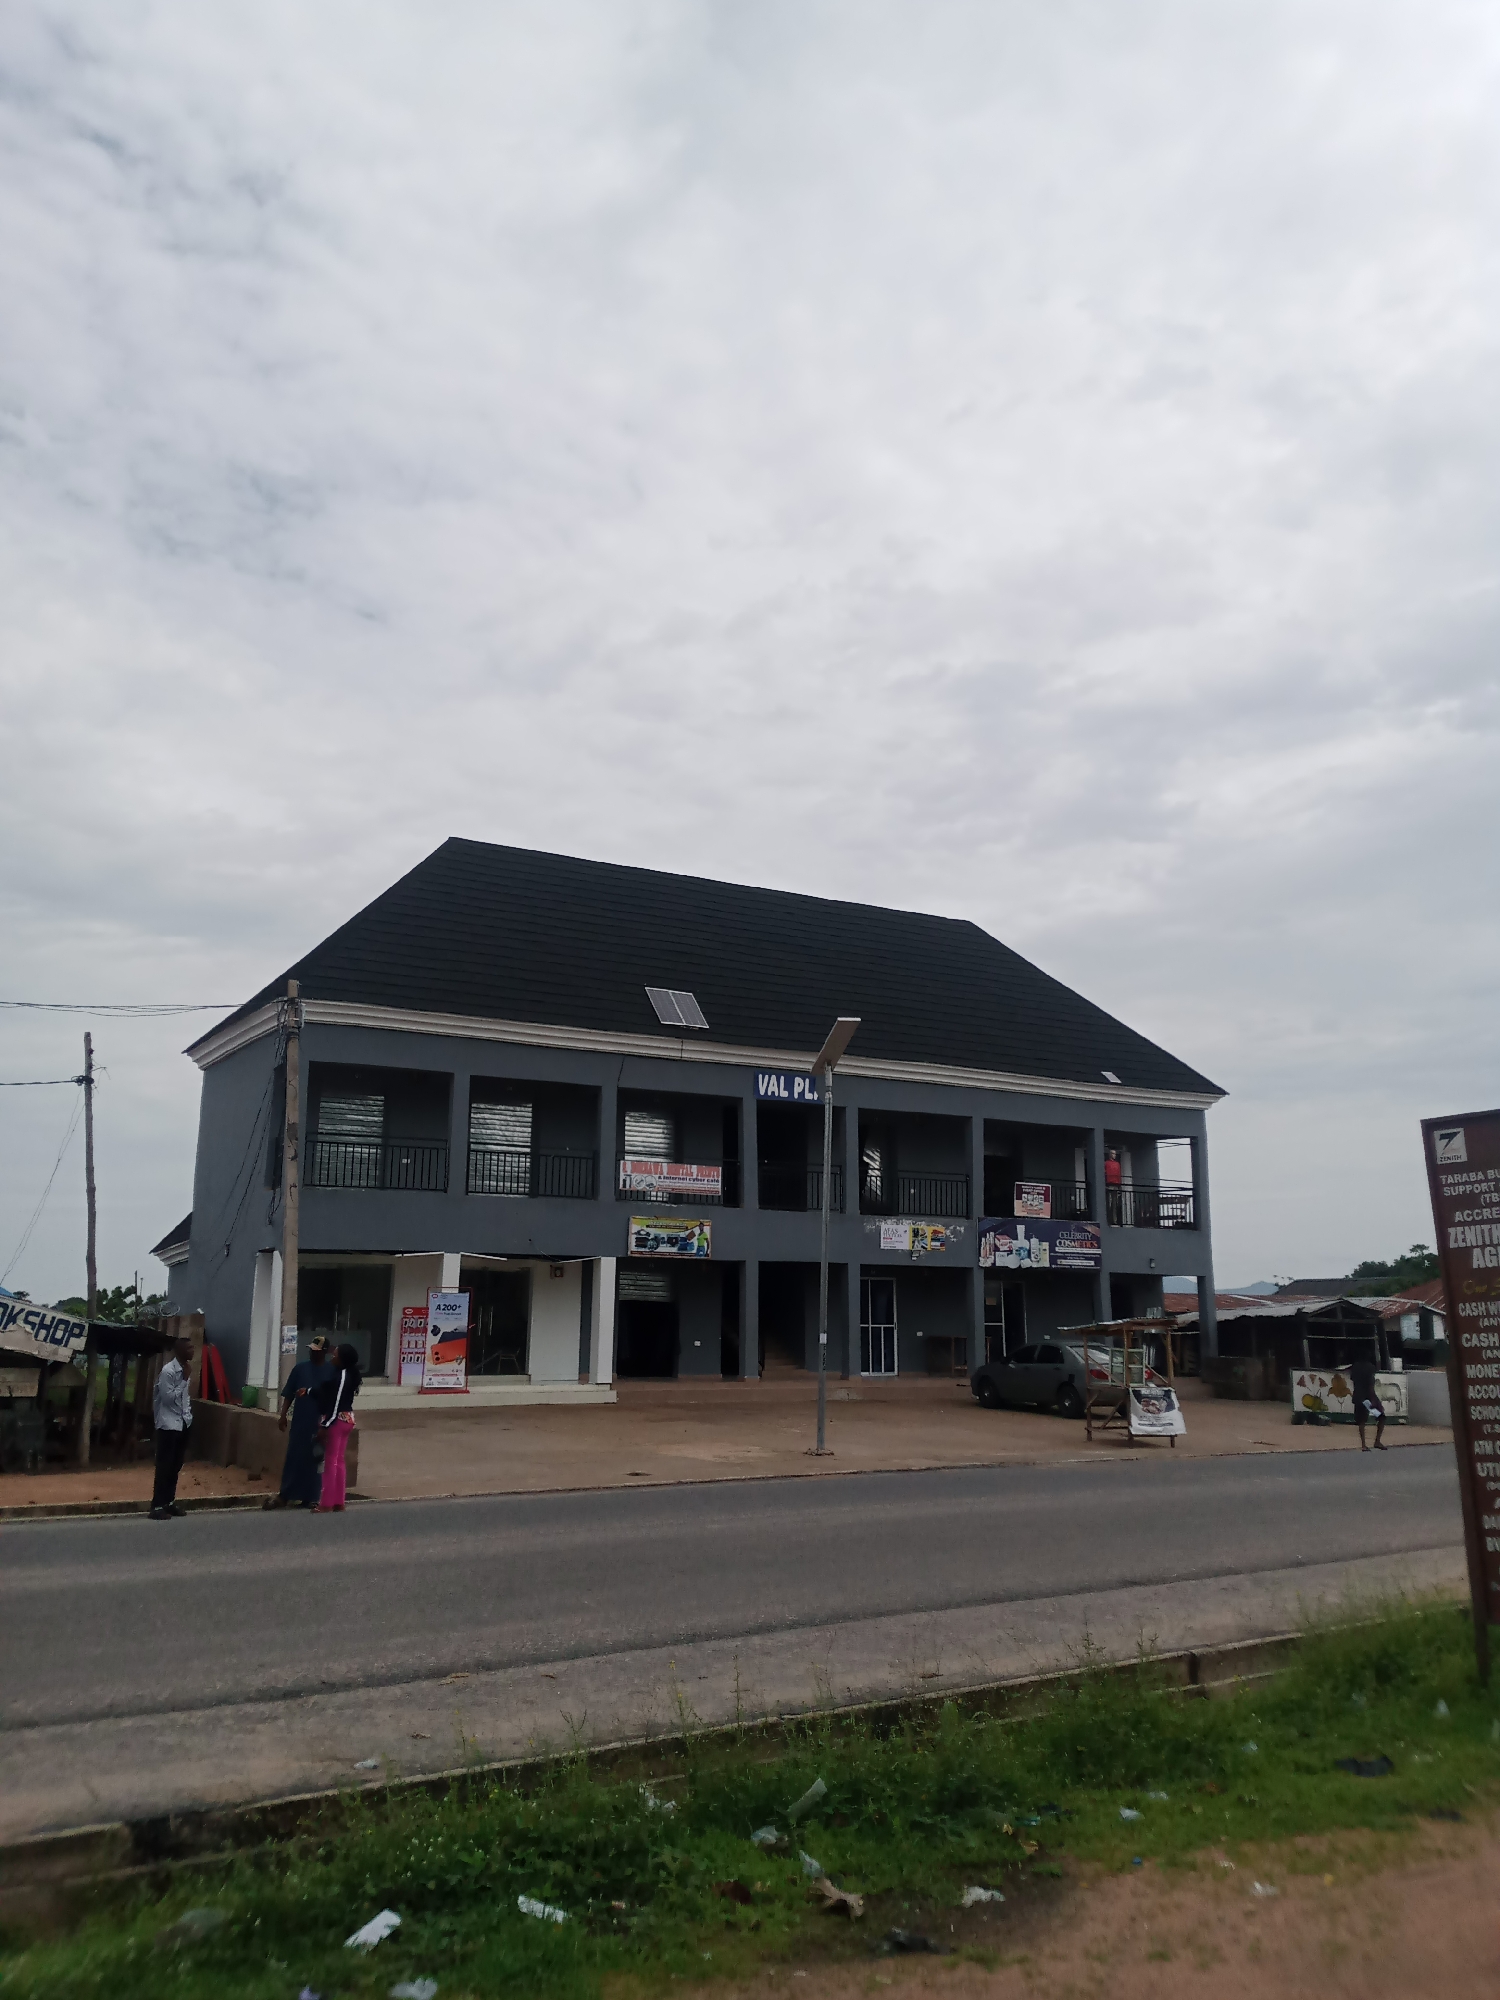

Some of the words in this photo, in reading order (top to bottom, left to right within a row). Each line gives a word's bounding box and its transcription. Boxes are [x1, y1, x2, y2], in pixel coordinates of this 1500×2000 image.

[758, 1074, 789, 1098] VAL
[1440, 1171, 1485, 1185] TARABA
[1443, 1182, 1496, 1197] SUPPORT
[1059, 1231, 1093, 1240] CELEBRITY
[1448, 1225, 1500, 1249] ZENITH
[1055, 1239, 1098, 1249] COSMETICS
[1458, 1301, 1487, 1317] CASH
[1461, 1332, 1499, 1348] CASH
[1465, 1363, 1500, 1380] MONE
